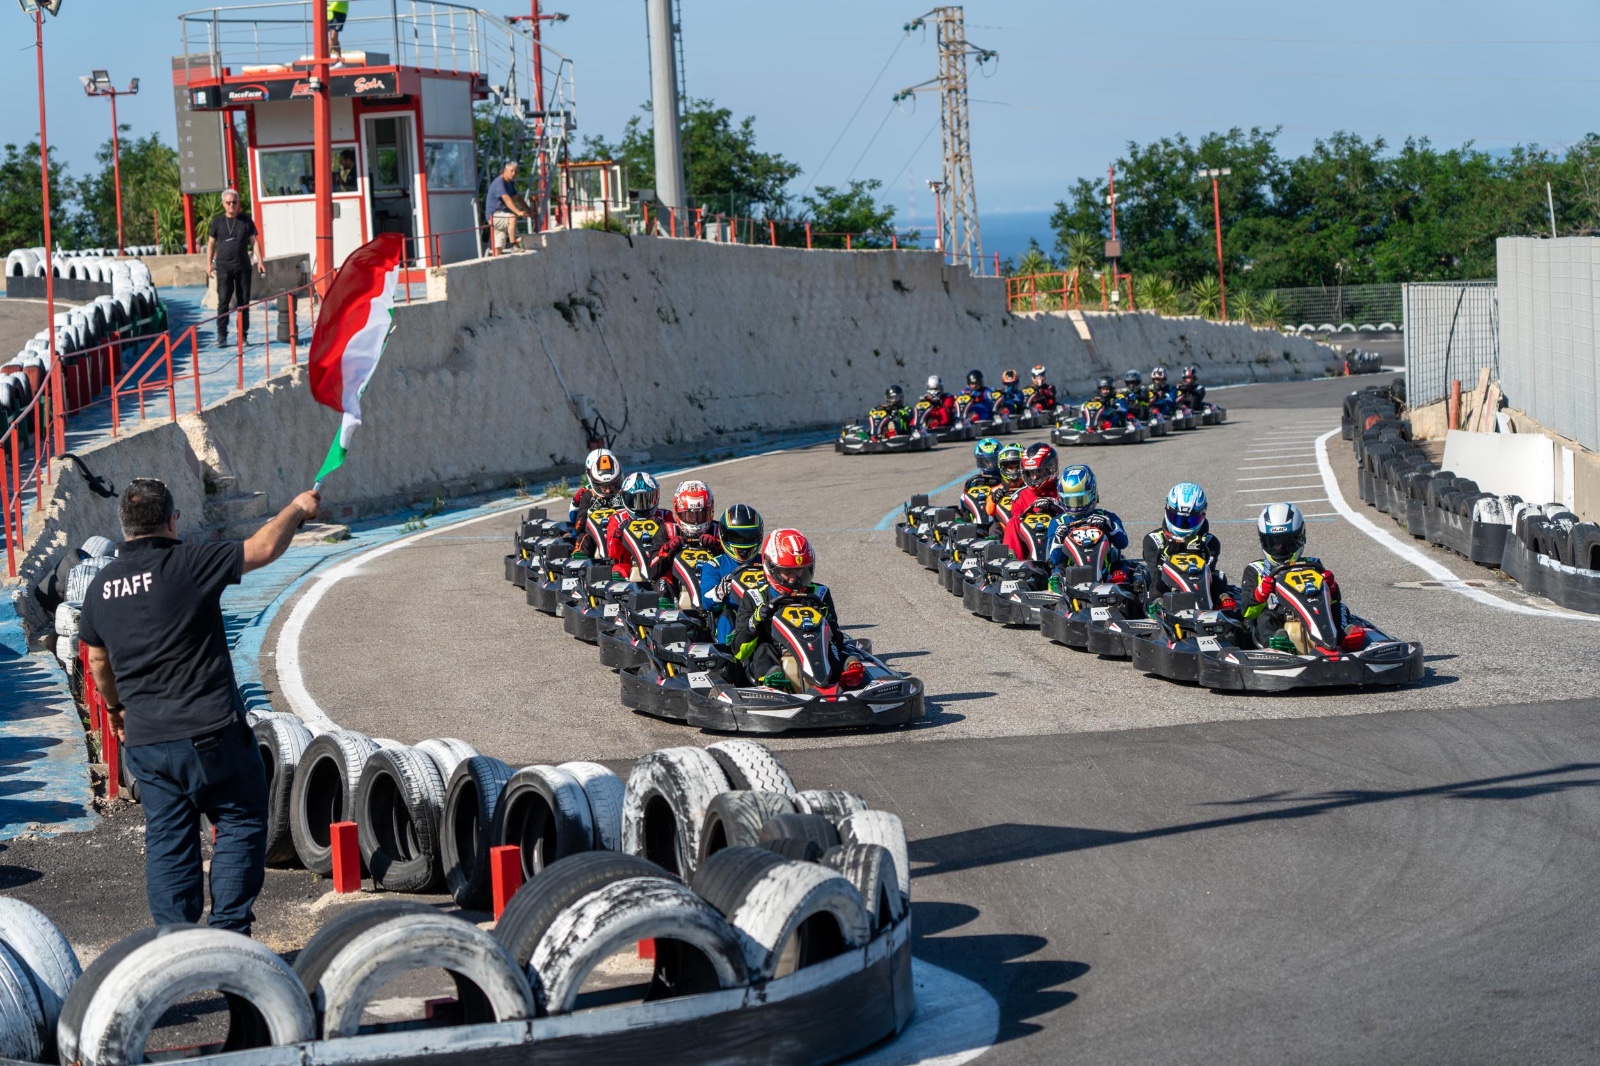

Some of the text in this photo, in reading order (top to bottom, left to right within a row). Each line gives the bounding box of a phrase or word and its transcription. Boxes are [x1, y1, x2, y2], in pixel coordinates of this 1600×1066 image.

[229, 90, 262, 99] RaceFacer
[1028, 516, 1050, 524] 39
[632, 523, 656, 532] 30
[1073, 529, 1100, 542] 36
[684, 552, 709, 561] 34
[1175, 557, 1198, 565] 31
[1291, 573, 1316, 585] 15
[103, 572, 152, 600] STAFF
[788, 610, 814, 620] 19
